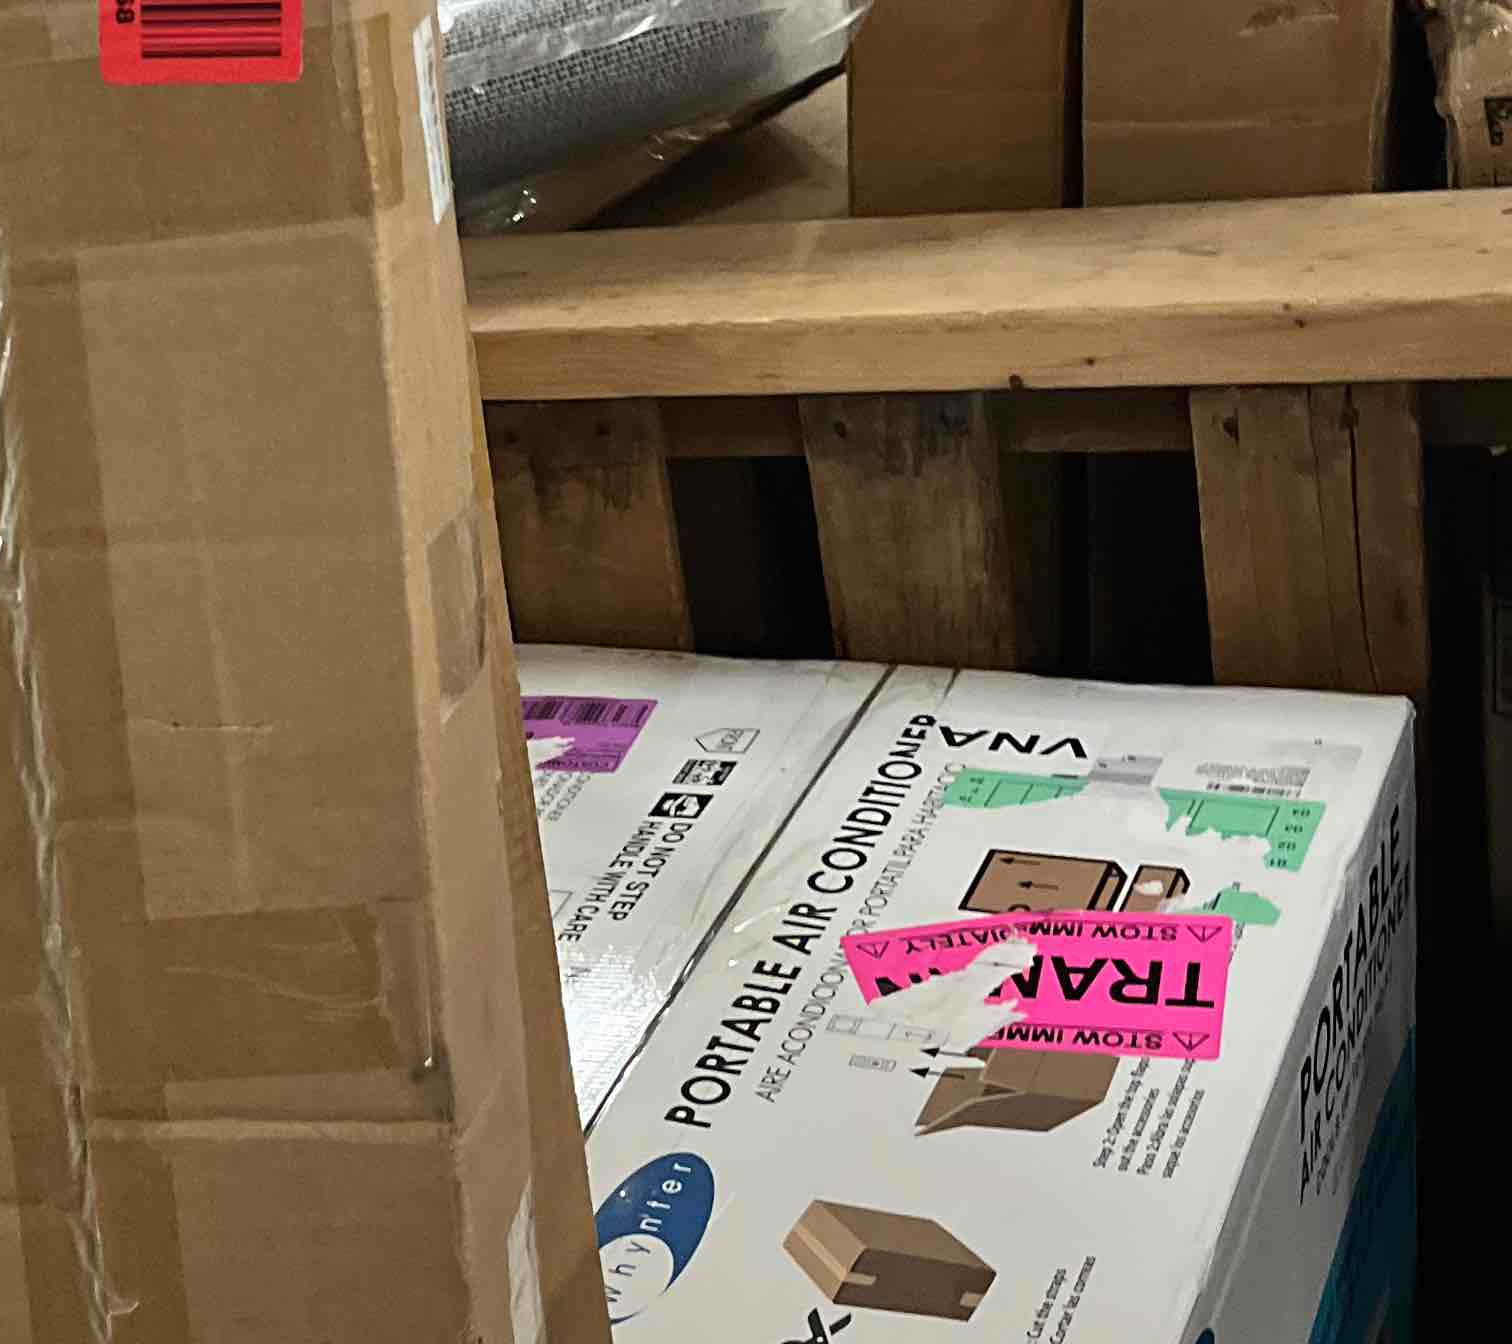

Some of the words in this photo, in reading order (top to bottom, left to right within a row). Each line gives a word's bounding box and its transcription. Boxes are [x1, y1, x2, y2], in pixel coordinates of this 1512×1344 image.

[609, 820, 663, 870] HANDLE
[661, 821, 693, 844] DO
[637, 845, 675, 879] NOT
[584, 870, 626, 904] WITH
[608, 880, 650, 922] STEP
[558, 903, 600, 944] CARE
[1094, 924, 1178, 943] STOW
[1300, 804, 1402, 1145] PORTABLE
[664, 957, 802, 1130] PORTABLE
[773, 900, 838, 956] AIR
[1074, 1030, 1163, 1050] STOW
[753, 1054, 801, 1104] AIRE
